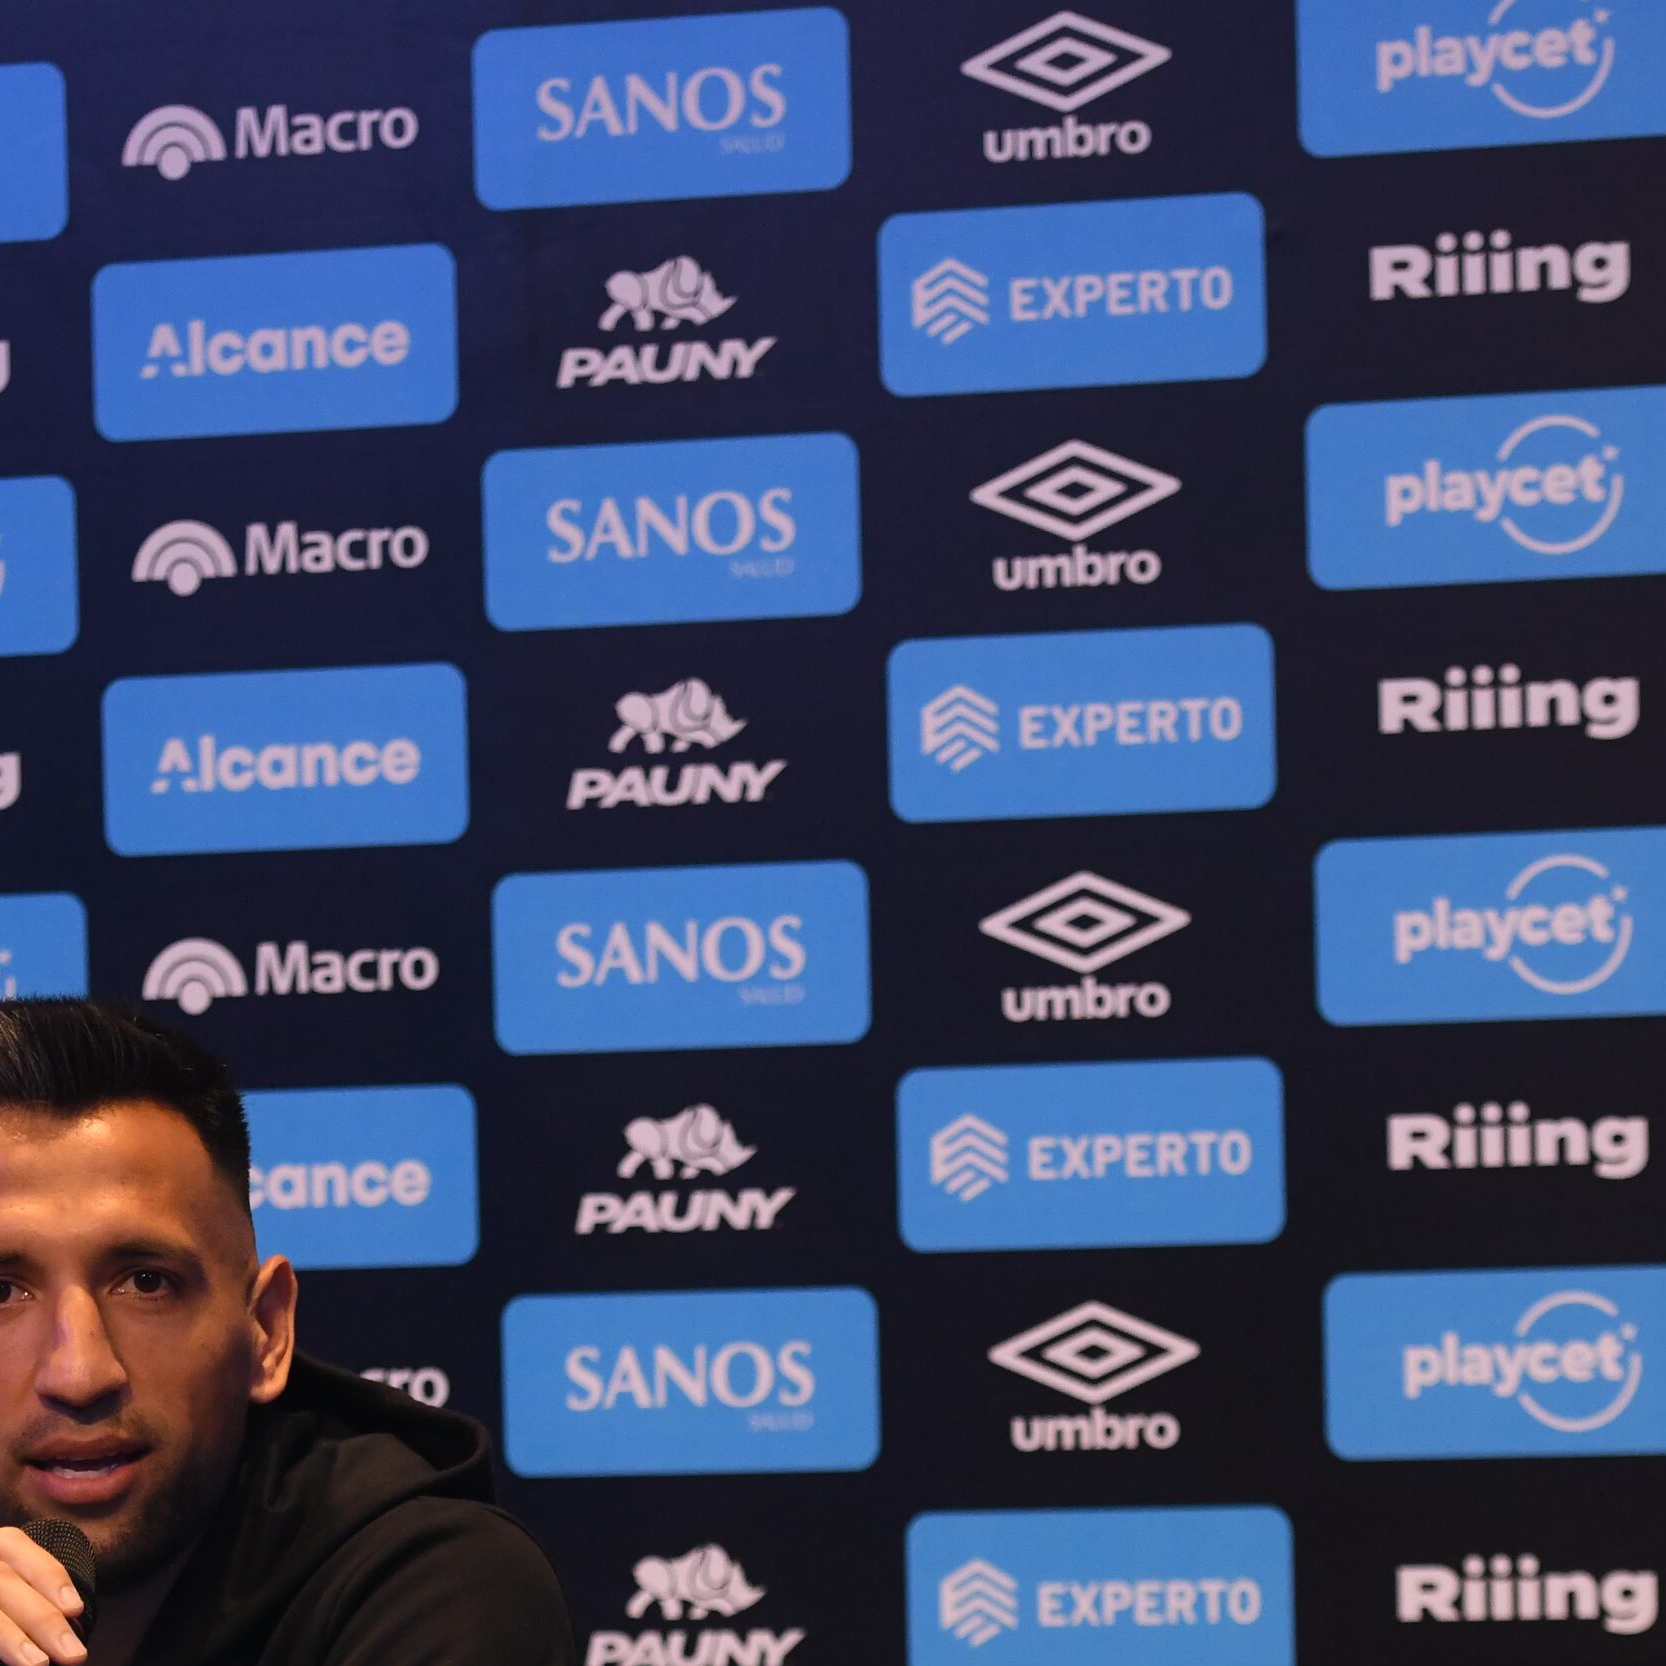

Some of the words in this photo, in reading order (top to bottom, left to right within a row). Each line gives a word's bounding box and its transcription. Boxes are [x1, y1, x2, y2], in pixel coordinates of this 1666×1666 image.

[1377, 17, 1596, 94] playcet
[537, 64, 786, 141] SANOS
[235, 105, 418, 158] Macro
[984, 115, 1151, 162] umbro
[1010, 266, 1233, 321] EXPERTO
[1370, 230, 1630, 303] Riiing
[141, 320, 410, 378] Alcance
[557, 337, 775, 388] PAUNY
[1386, 449, 1605, 526] playcet
[245, 521, 428, 575] Macro
[547, 488, 796, 563] SANOS
[993, 544, 1161, 590] umbro
[1019, 697, 1242, 749] EXPERTO
[1379, 664, 1639, 739] Riiing
[152, 735, 420, 793] Alcance
[567, 761, 785, 809] PAUNY
[557, 915, 805, 987] SANOS
[1395, 897, 1616, 965] playcet
[255, 941, 438, 995] Macro
[1002, 976, 1170, 1022] umbro
[1028, 1130, 1252, 1180] EXPERTO
[1388, 1103, 1648, 1179] Riiing
[576, 1188, 794, 1234] PAUNY
[566, 1341, 814, 1411] SANOS
[1404, 1330, 1626, 1401] playcet
[1011, 1406, 1180, 1451] umbro
[1037, 1578, 1261, 1627] EXPERTO
[1397, 1555, 1658, 1634] Riiing
